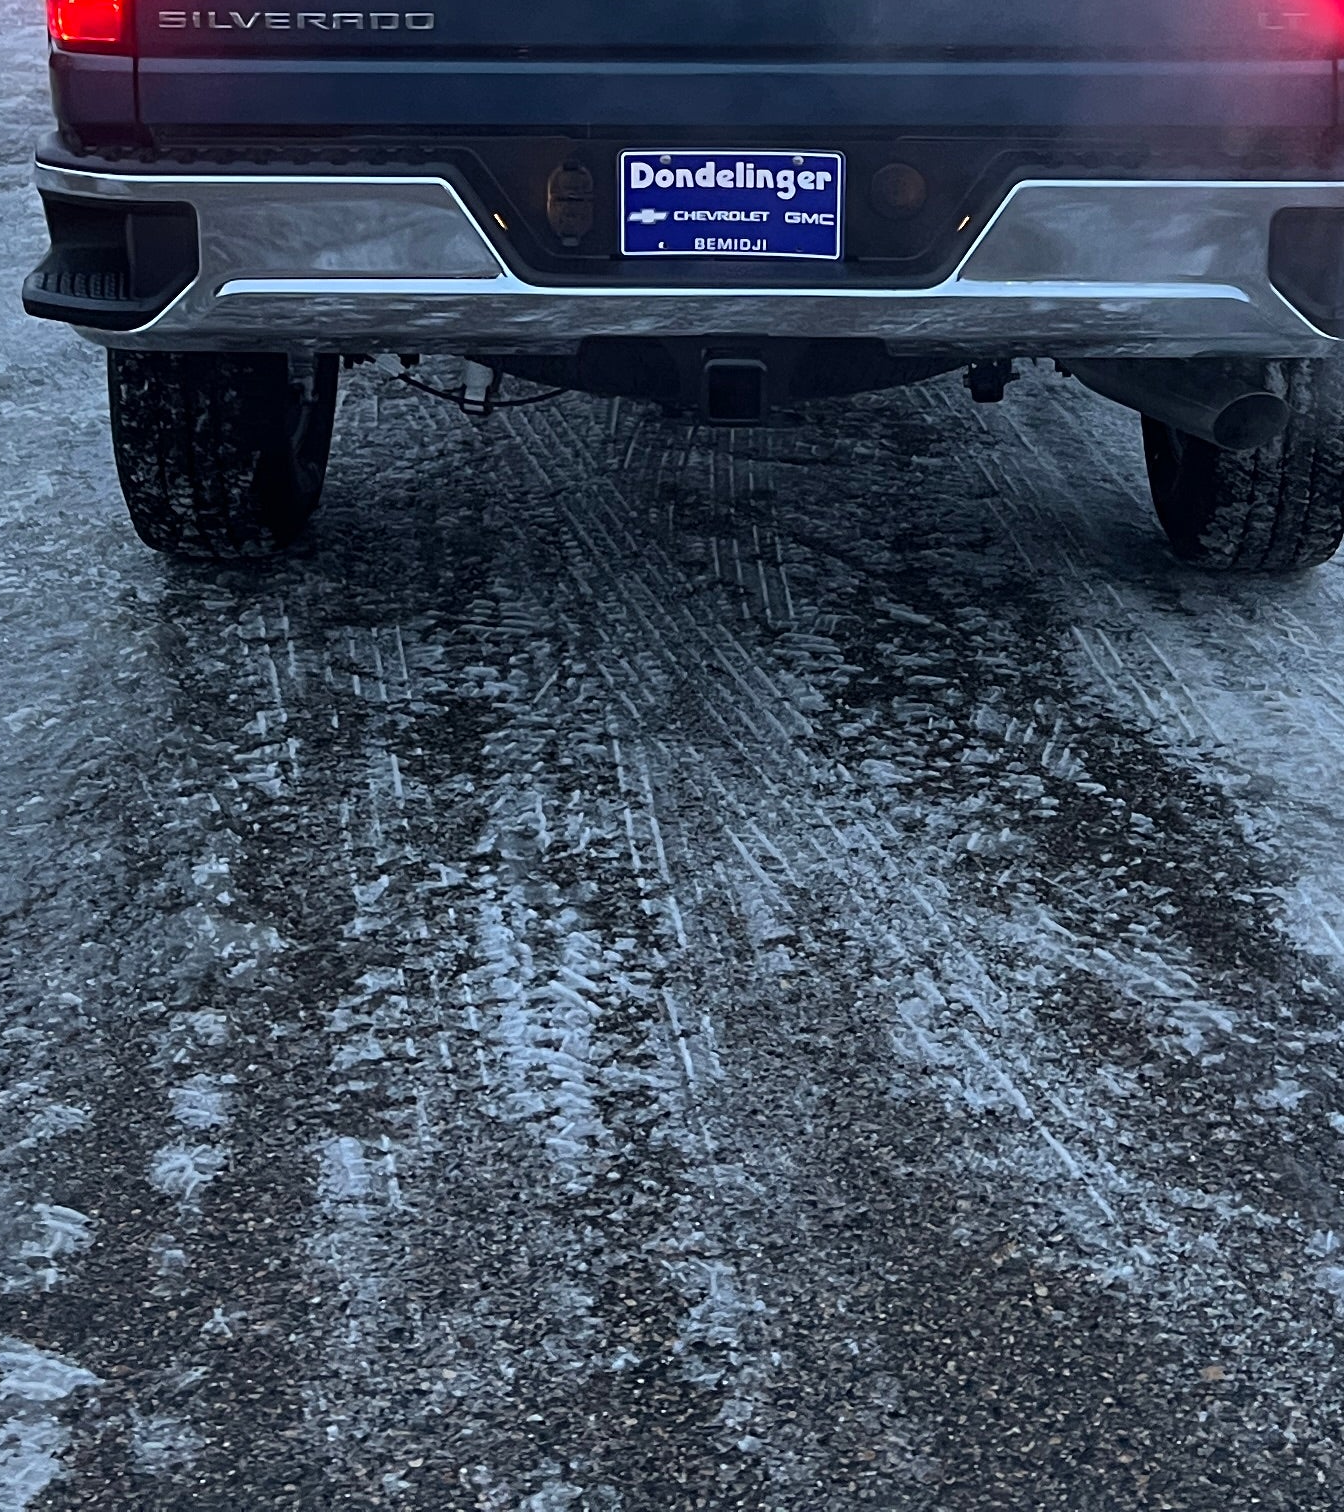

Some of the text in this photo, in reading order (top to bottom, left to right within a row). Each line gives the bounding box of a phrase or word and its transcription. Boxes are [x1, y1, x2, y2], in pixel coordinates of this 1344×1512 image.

[158, 10, 435, 31] SILVERADO
[630, 161, 832, 200] Dondelinger
[672, 210, 835, 226] CHEVROLET GMC
[694, 237, 768, 251] BEMIDJI
